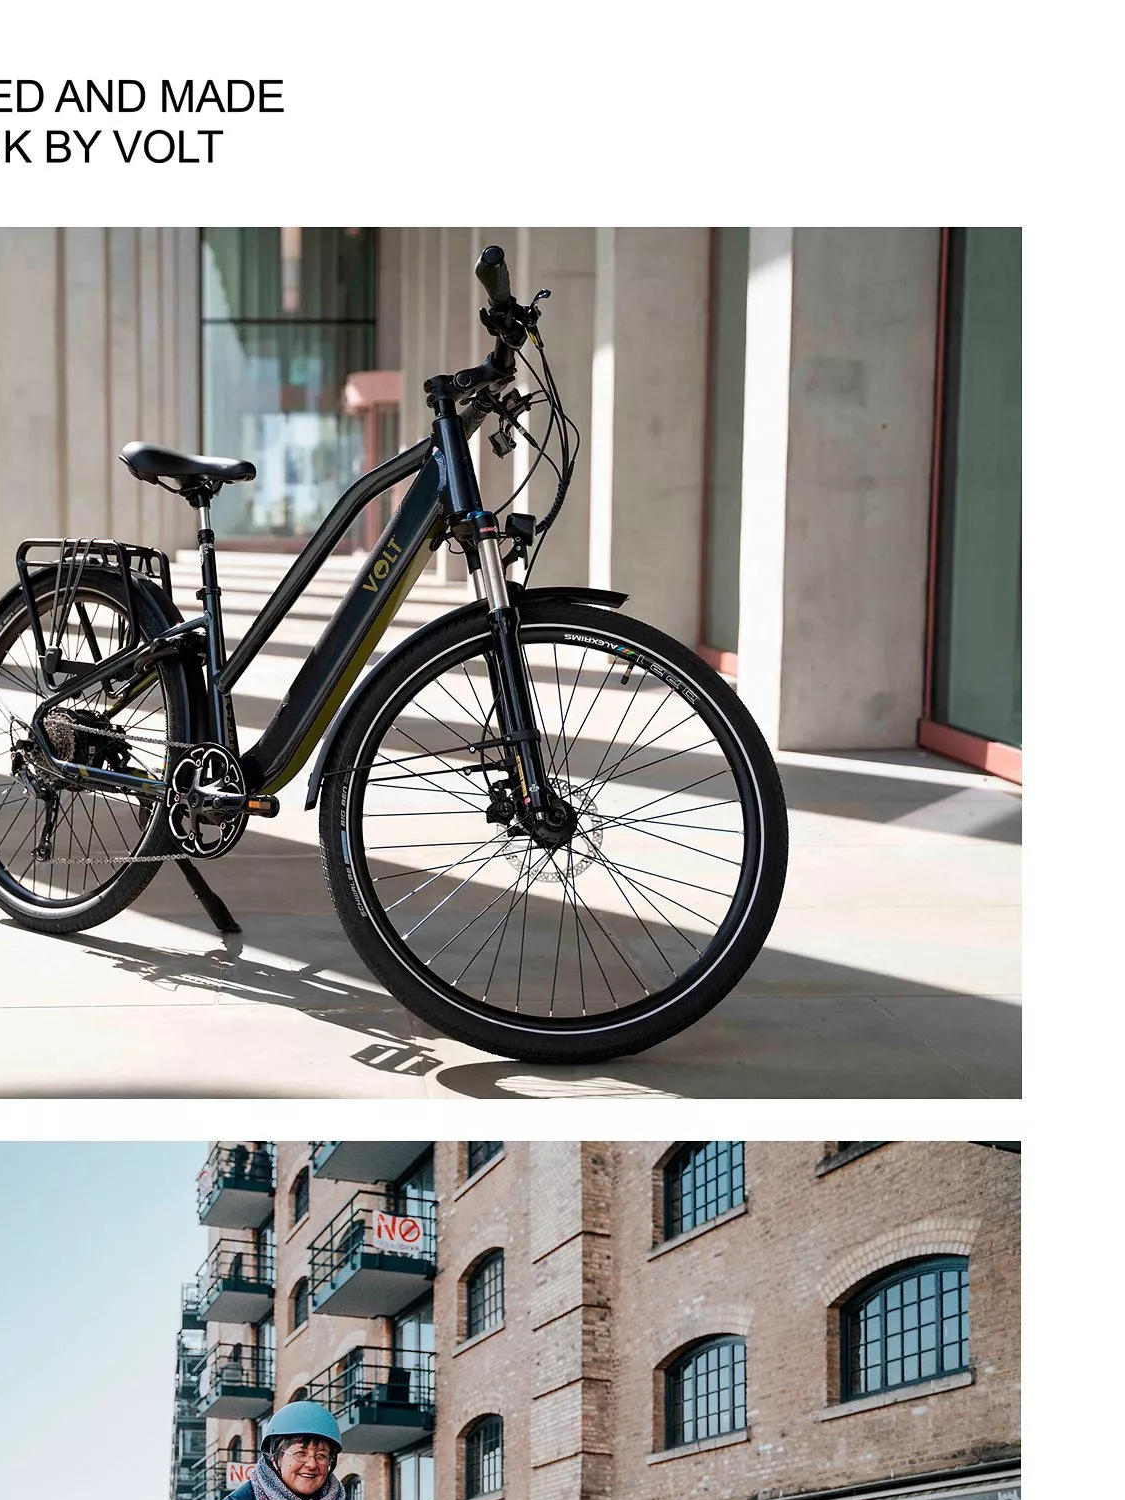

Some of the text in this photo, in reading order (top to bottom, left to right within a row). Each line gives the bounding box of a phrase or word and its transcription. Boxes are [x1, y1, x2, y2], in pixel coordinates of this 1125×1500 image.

[362, 536, 403, 592] VOLT
[564, 633, 618, 651] ALEXRIMS
[345, 866, 368, 919] SCHWALBE
[377, 1213, 421, 1243] NO
